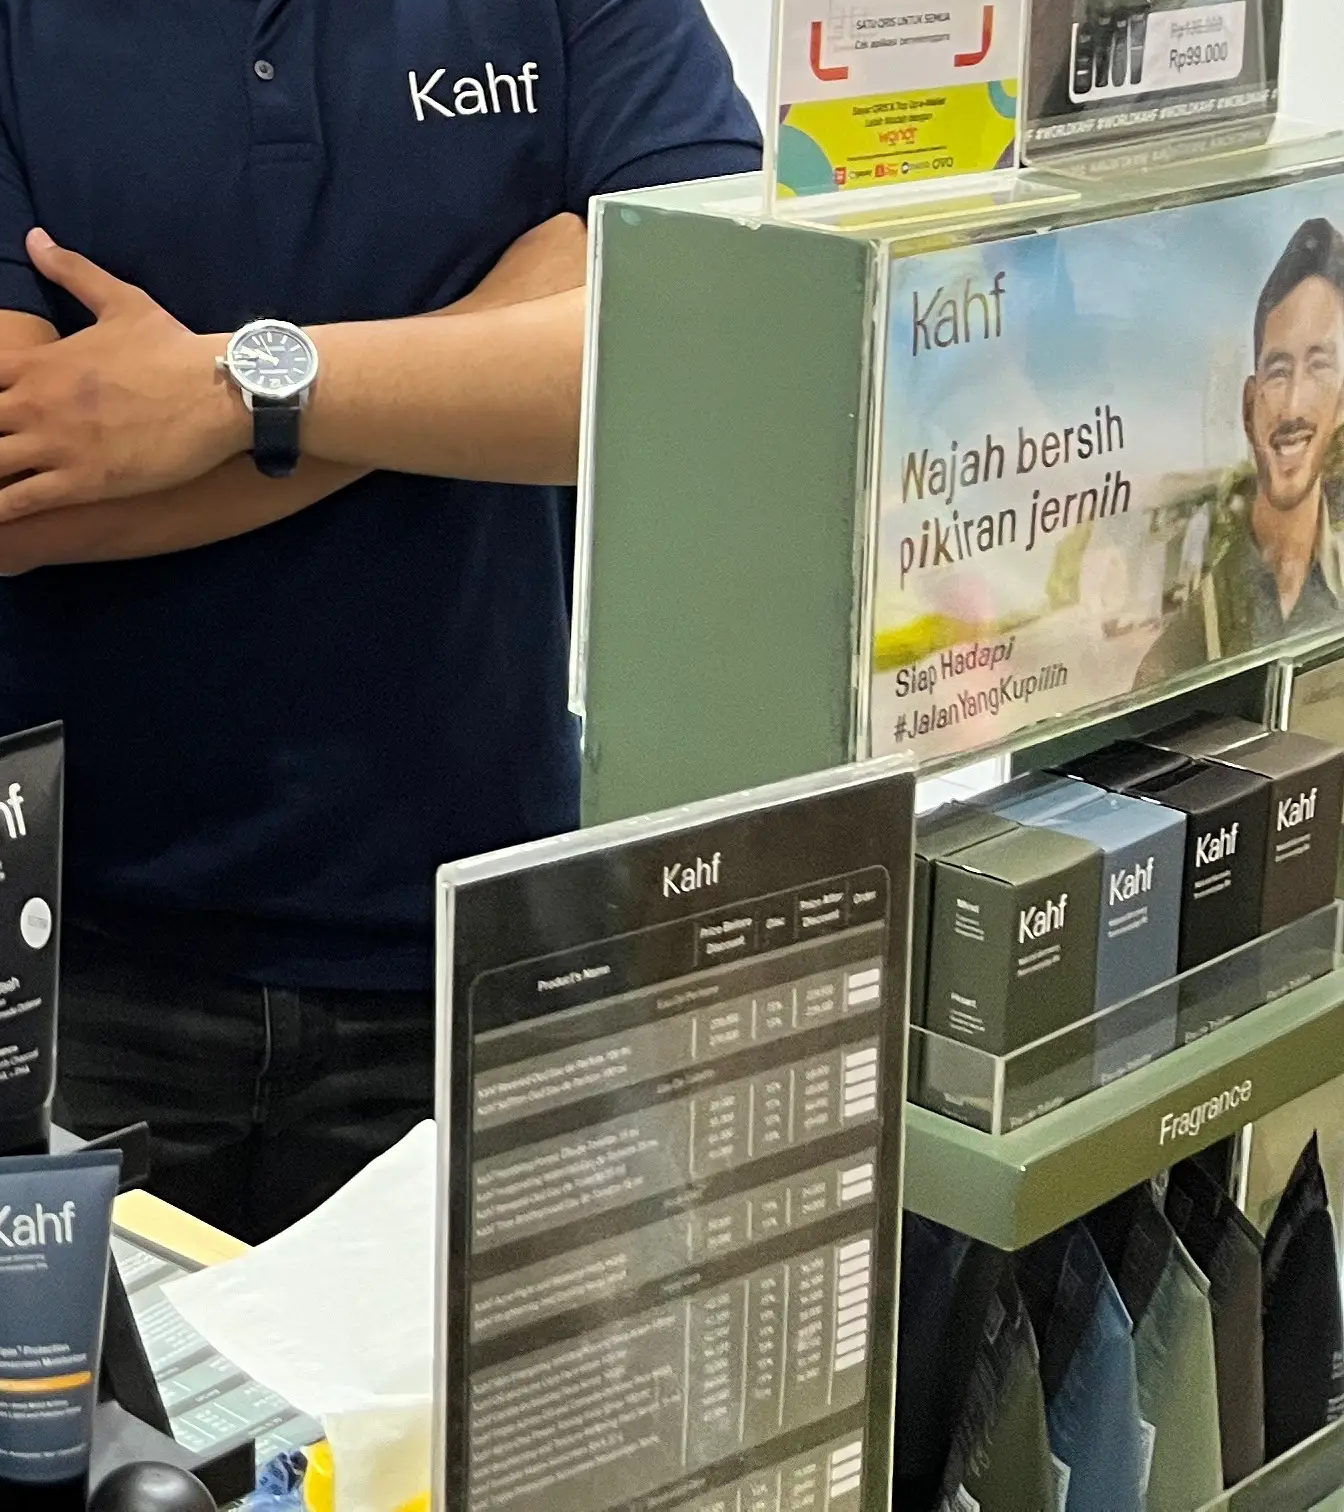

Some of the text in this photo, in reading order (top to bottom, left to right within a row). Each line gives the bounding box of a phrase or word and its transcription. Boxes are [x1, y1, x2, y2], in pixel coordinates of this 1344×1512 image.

[1169, 42, 1228, 72] Rp99.000
[408, 61, 540, 121] Kahf
[911, 271, 1006, 358] Kahf
[900, 405, 1125, 505] Wajah bersih
[899, 470, 1131, 590] pikiran jernih
[895, 636, 1016, 700] Siap Hadapi
[892, 662, 1068, 745] #JalanYangKupilih
[1276, 787, 1318, 832] Kahf
[663, 852, 721, 897] Kahf
[1195, 821, 1239, 868] Kahf
[1109, 857, 1154, 906] Kahf
[1018, 893, 1068, 945] Kahf
[1159, 1078, 1253, 1146] Fragrance
